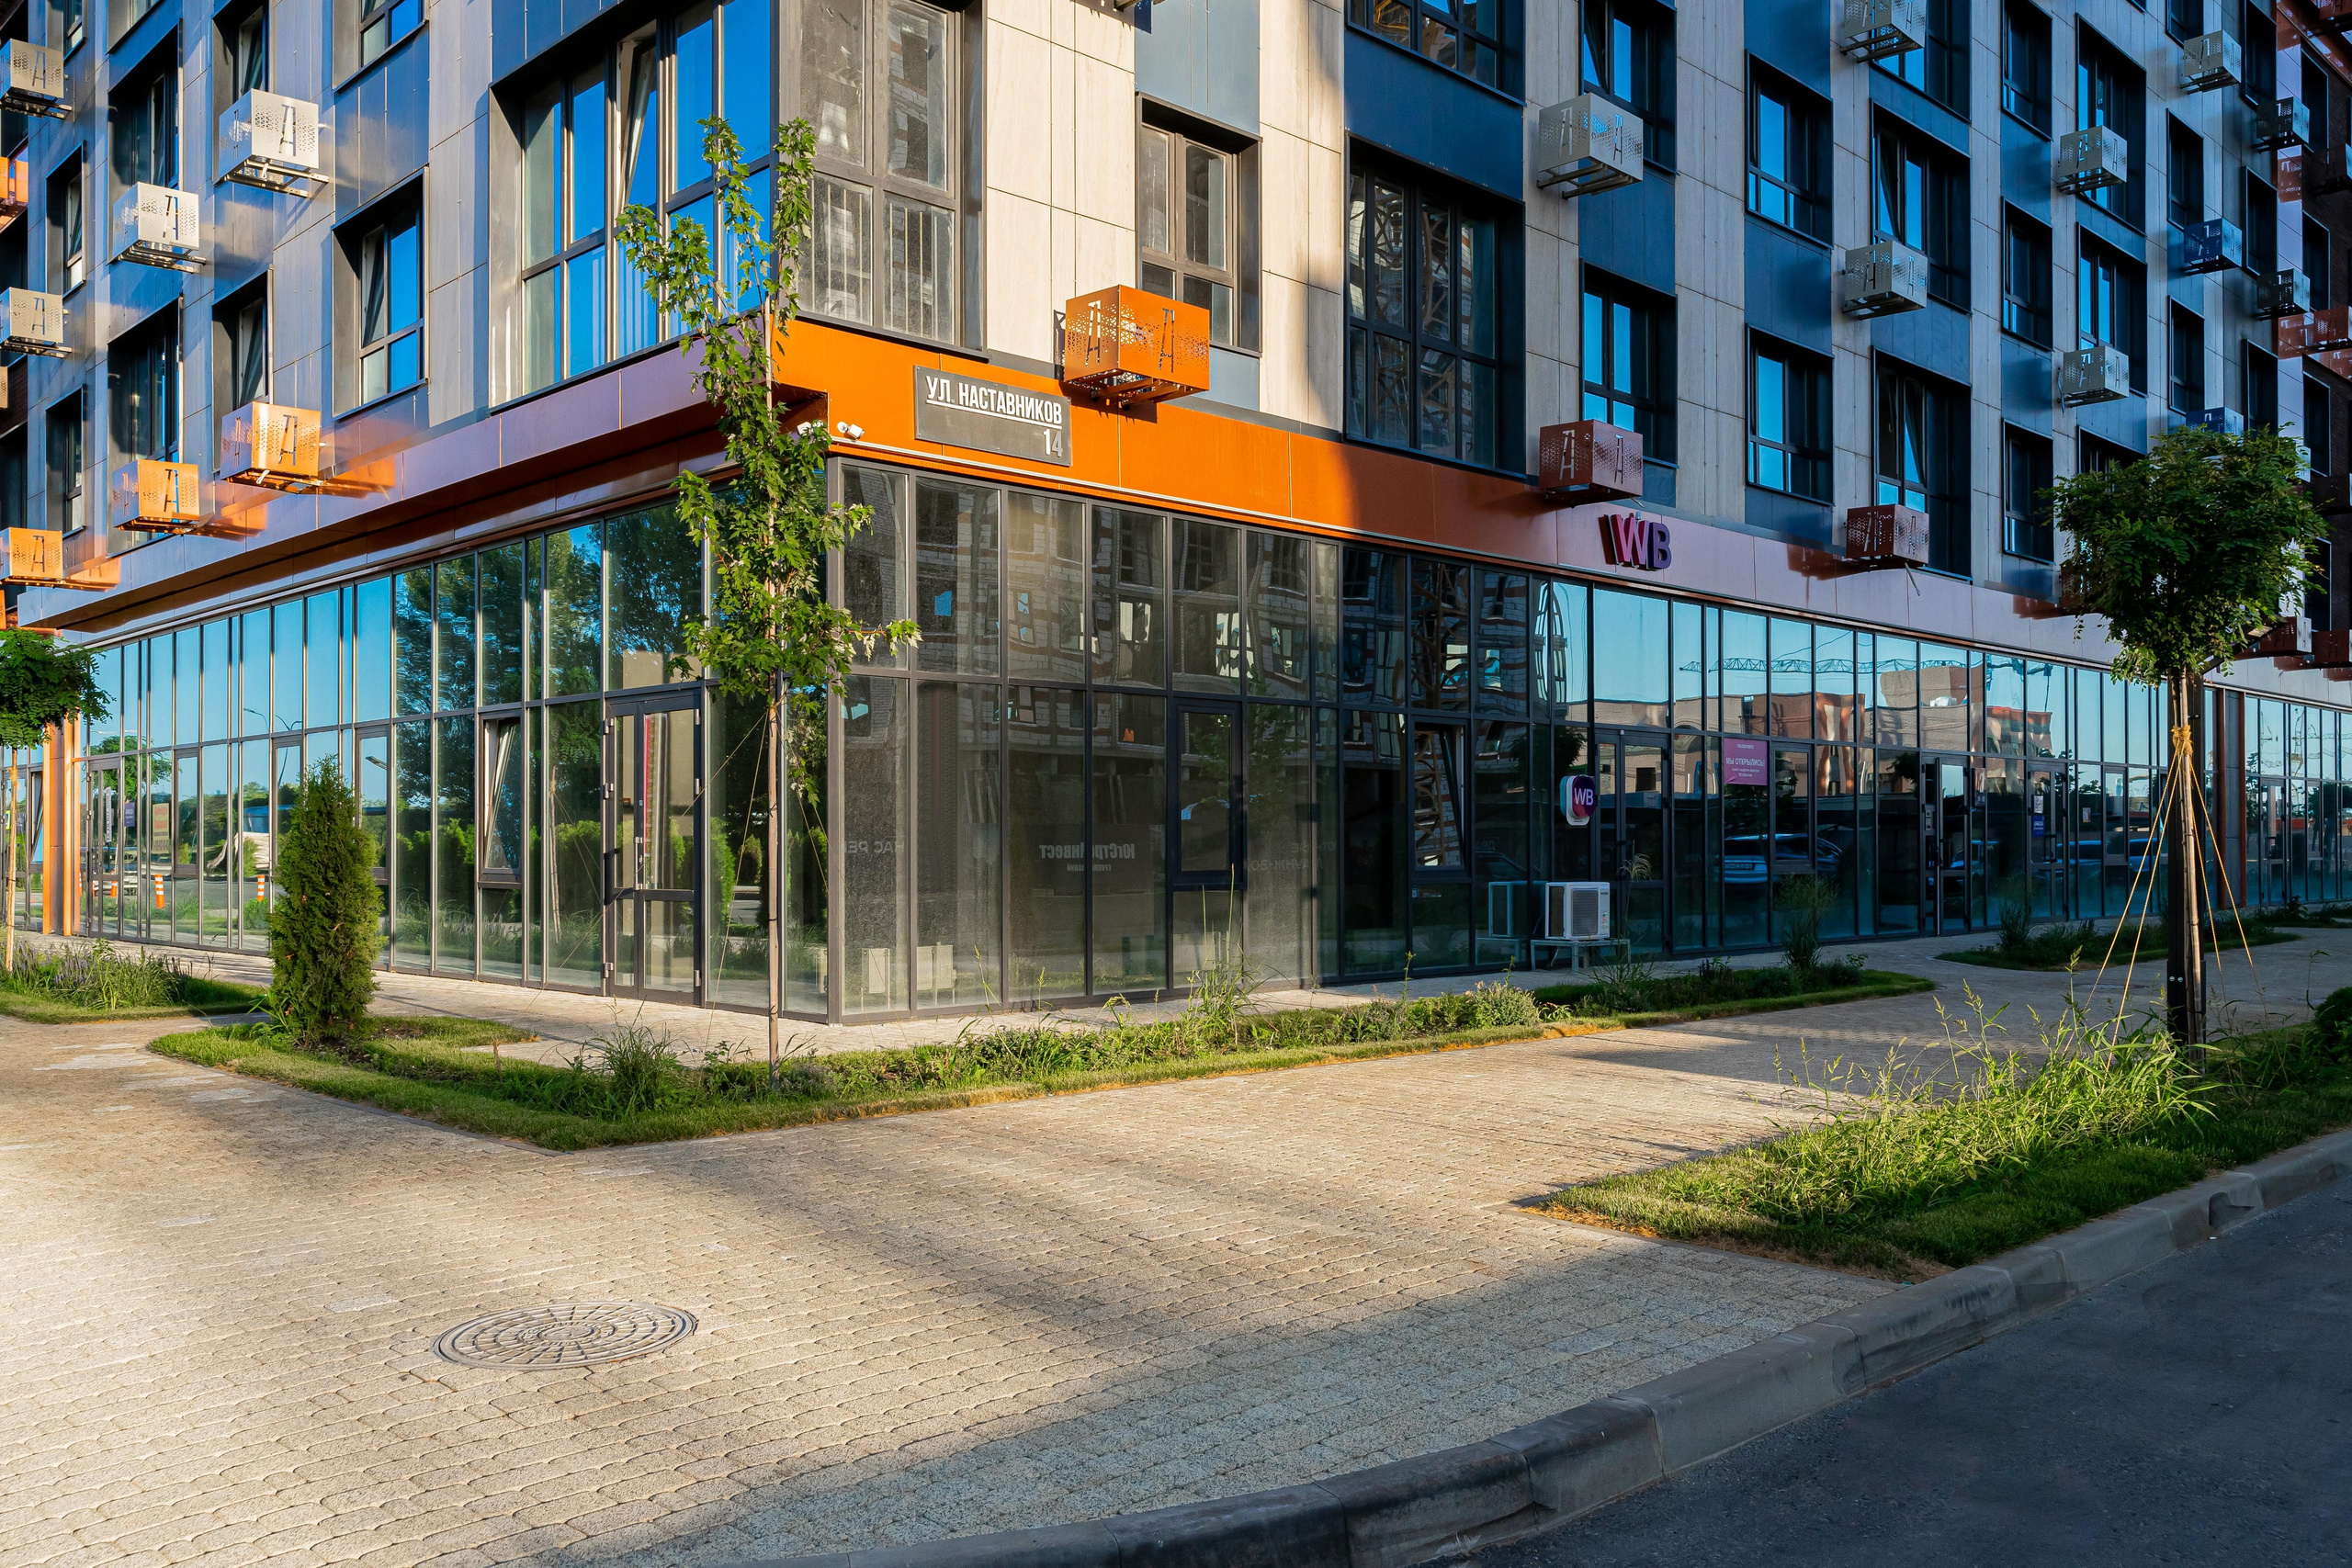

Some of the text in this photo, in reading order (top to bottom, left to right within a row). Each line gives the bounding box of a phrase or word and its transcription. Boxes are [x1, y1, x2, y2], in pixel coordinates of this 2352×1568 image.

[926, 376, 1063, 424] УЛ. НАСТАВНИКОВ
[1043, 428, 1064, 457] 14
[1608, 513, 1672, 570] WB
[1725, 757, 1735, 765] МЫ
[1574, 787, 1594, 806] WB
